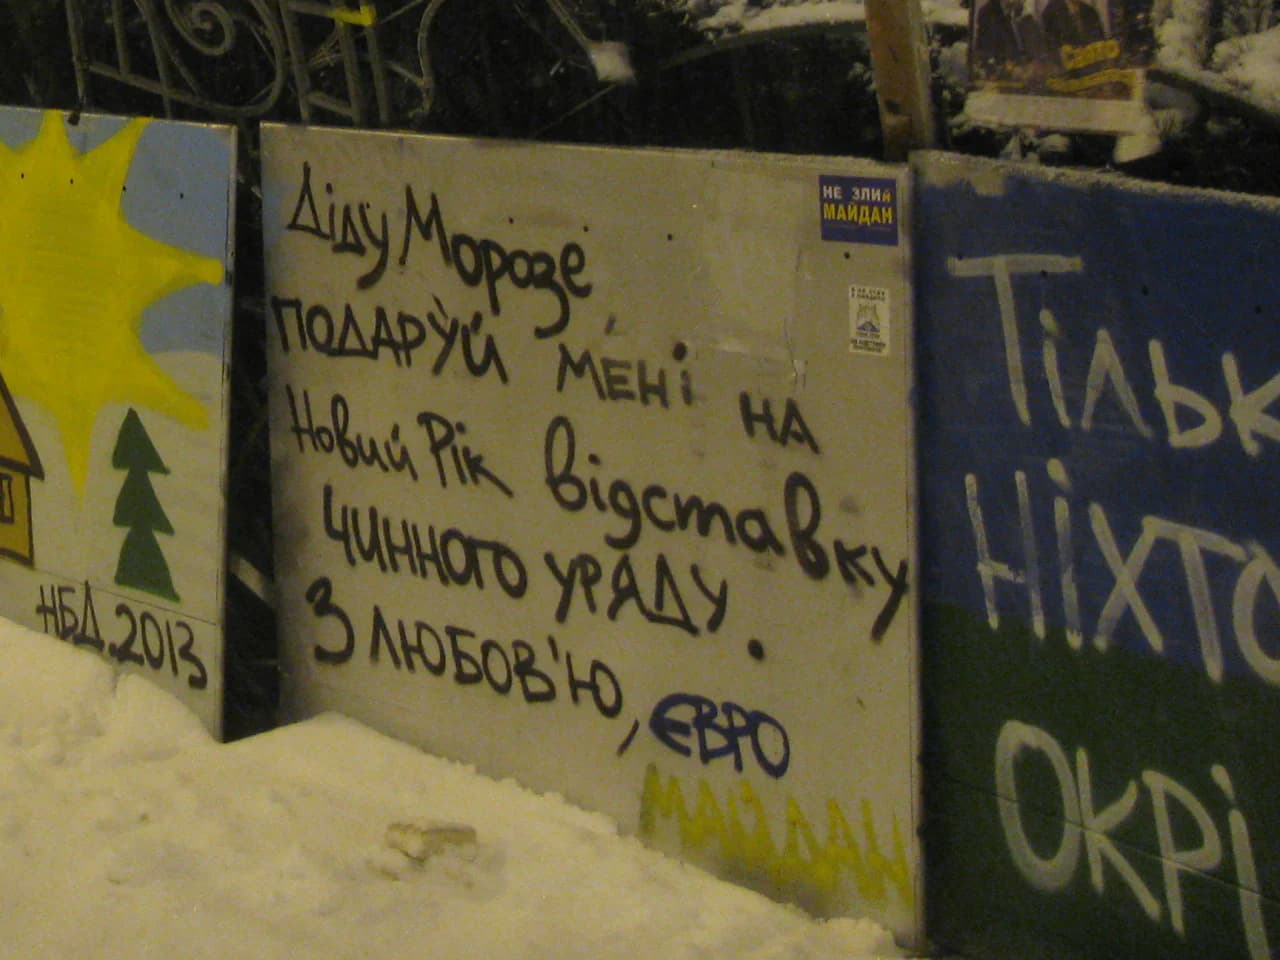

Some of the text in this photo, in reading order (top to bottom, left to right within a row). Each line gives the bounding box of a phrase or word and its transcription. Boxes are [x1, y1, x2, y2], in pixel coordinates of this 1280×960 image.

[286, 161, 389, 290] Діду
[823, 185, 842, 200] НЕ
[823, 202, 893, 227] МАЙДАН
[739, 391, 820, 456] НА
[286, 384, 909, 647] Новий Рік відставку
[306, 576, 356, 665] З
[649, 692, 792, 779] ЄВРО
